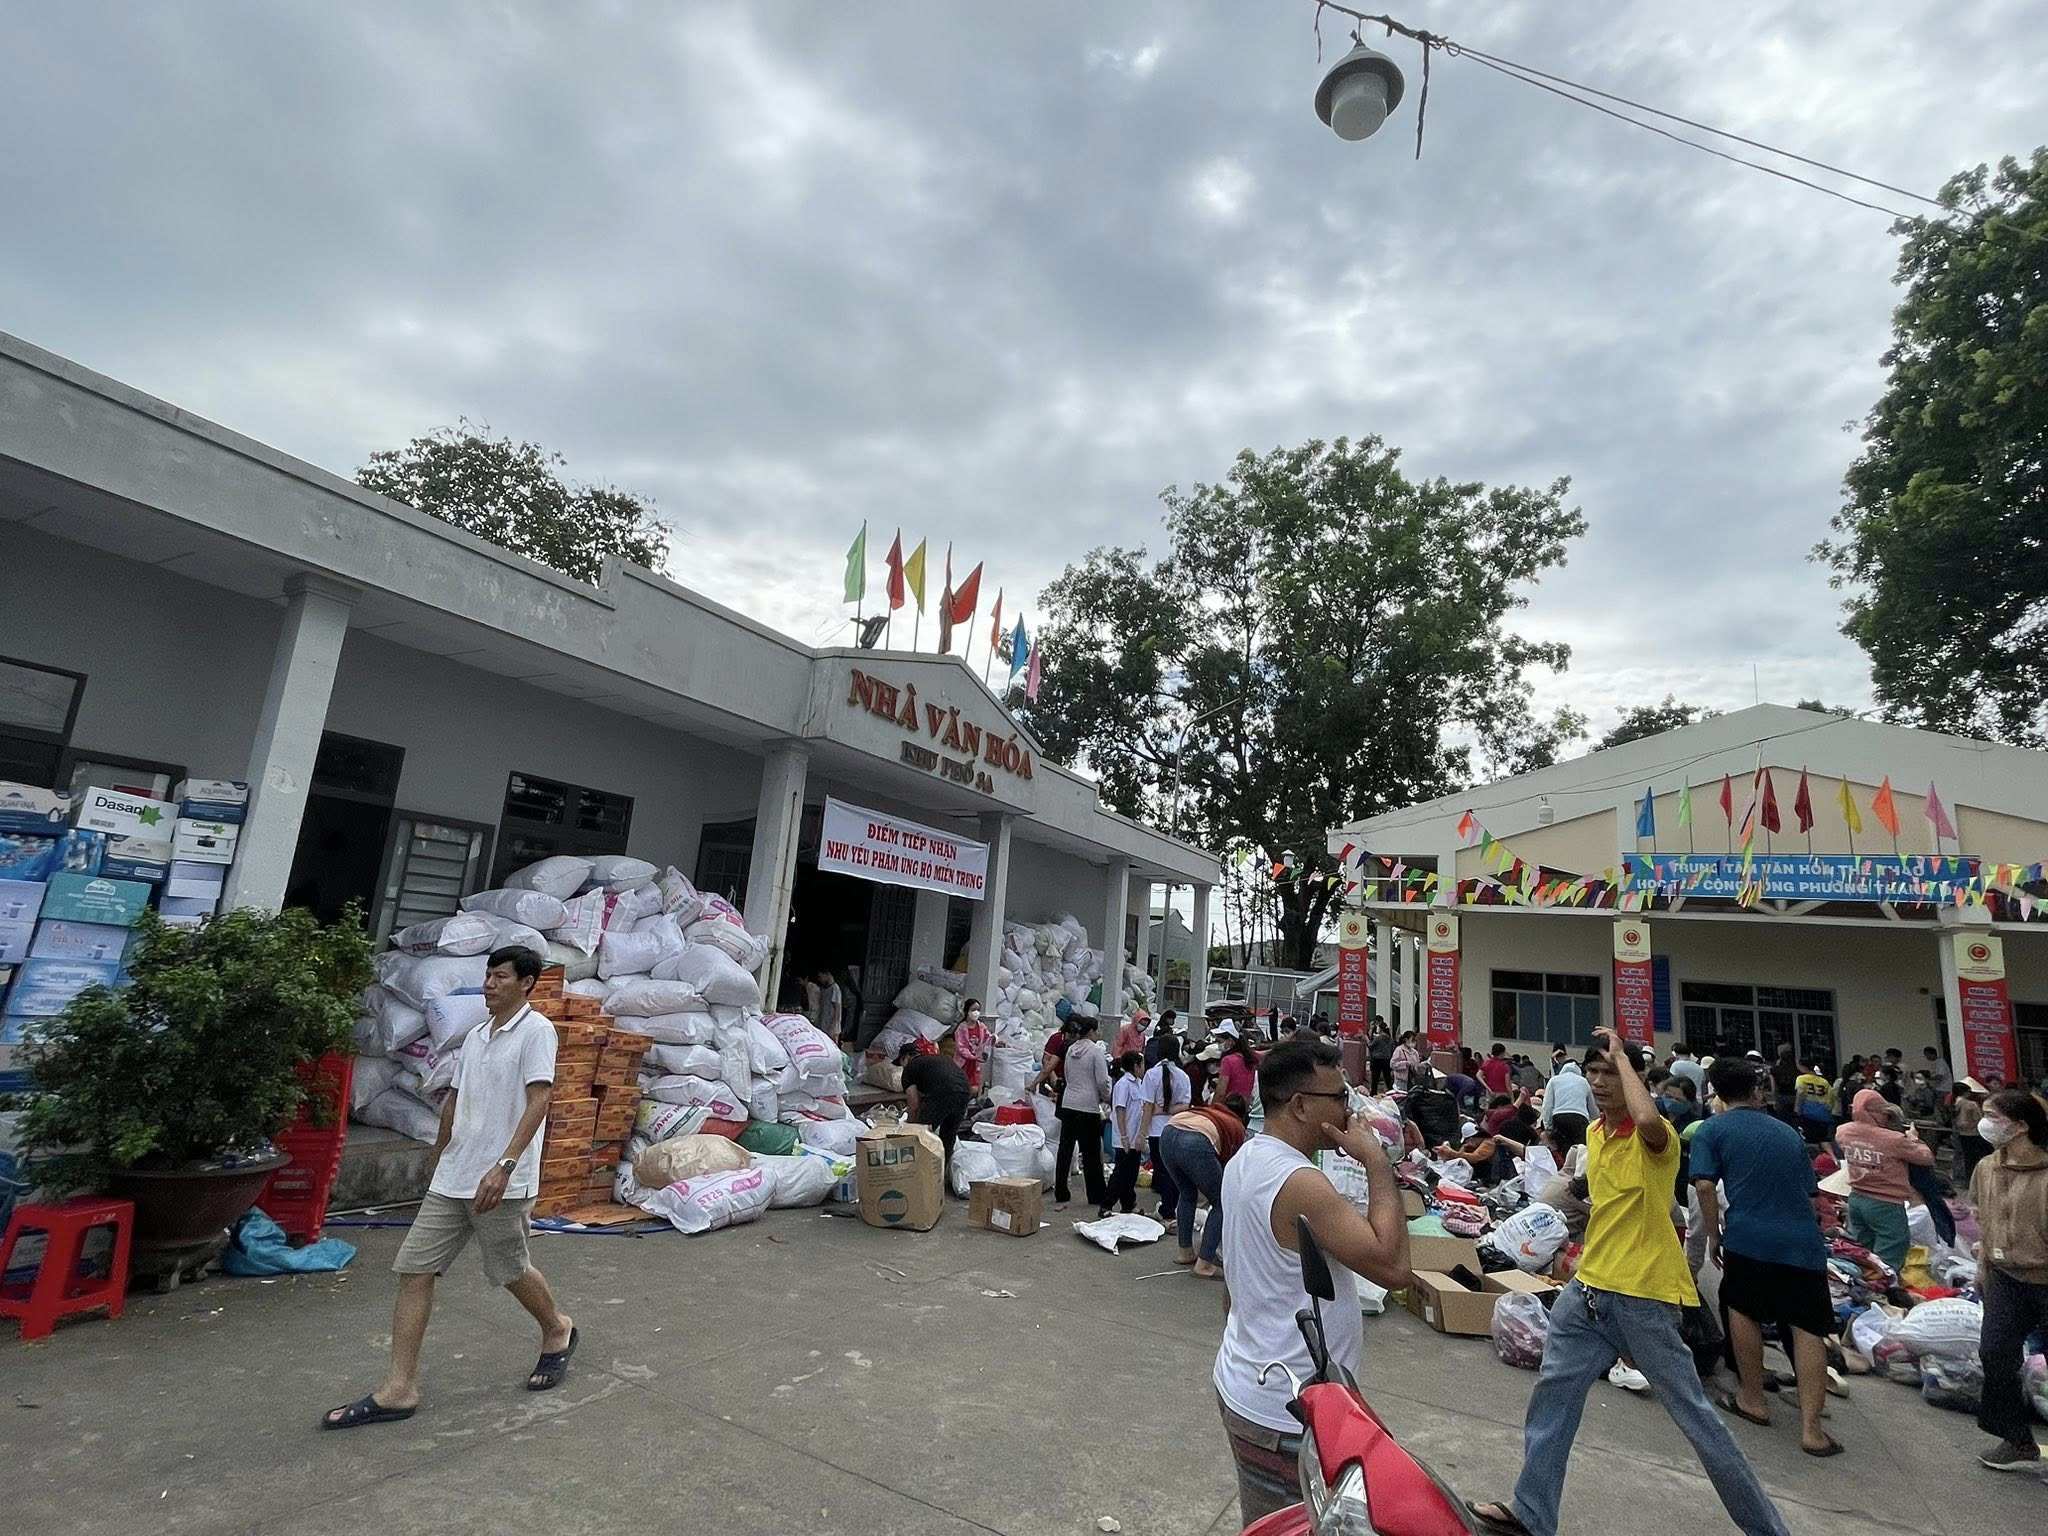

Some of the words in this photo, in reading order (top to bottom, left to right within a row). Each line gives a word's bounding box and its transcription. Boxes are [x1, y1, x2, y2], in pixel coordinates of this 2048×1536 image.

[848, 669, 919, 731] NHÀ
[925, 703, 982, 757] VĂN
[985, 733, 1032, 780] HÓA
[825, 840, 849, 861] NHU
[850, 842, 870, 866] YẾU
[919, 859, 933, 882] HỘ
[956, 870, 983, 890] TRUNG
[900, 832, 927, 852] TIẾP
[929, 840, 957, 861] NHẬN
[696, 1189, 724, 1208] ST25
